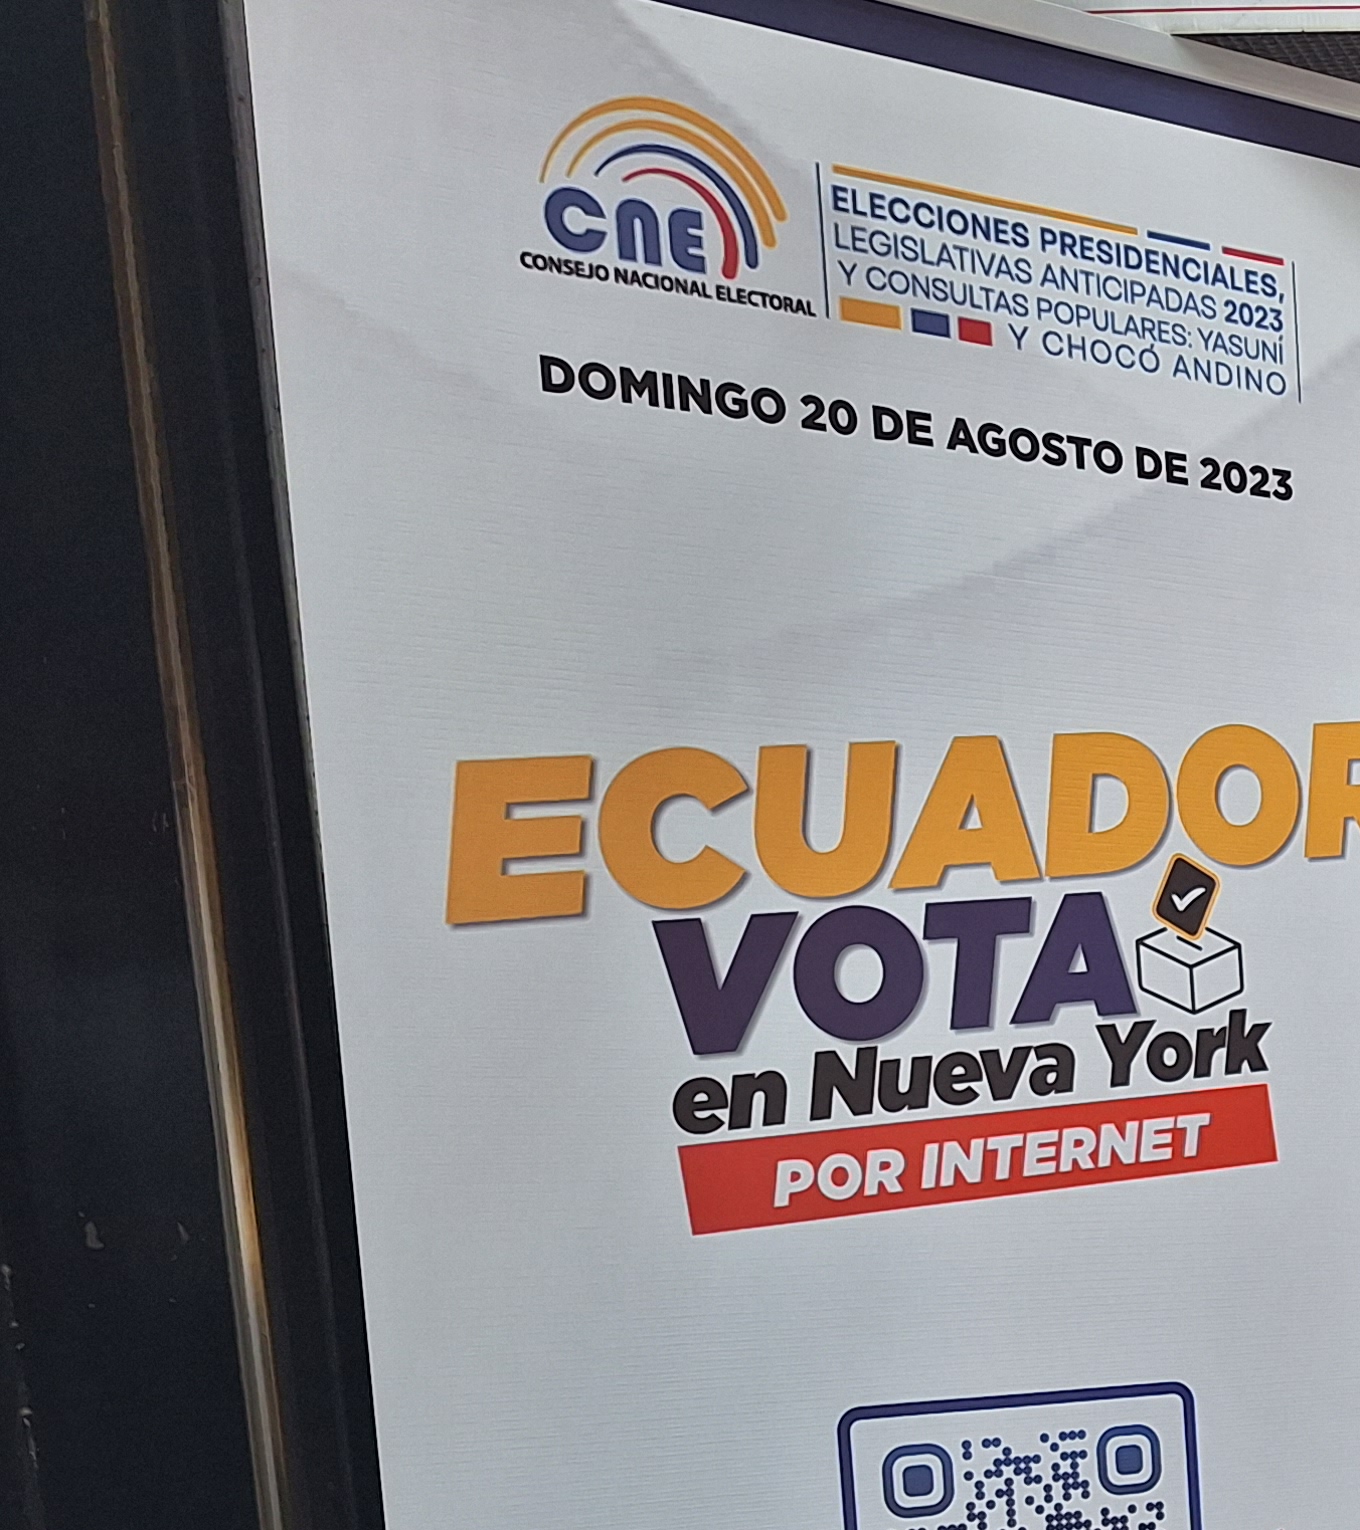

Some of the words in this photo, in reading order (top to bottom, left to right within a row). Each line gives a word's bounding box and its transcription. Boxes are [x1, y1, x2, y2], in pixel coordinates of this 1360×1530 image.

[520, 251, 610, 282] CONSEJO
[613, 265, 713, 299] NACIONAL
[715, 282, 817, 317] ELECTORAL
[830, 184, 1031, 249] ELECCIONES
[1039, 226, 1286, 303] PRESIDENCIALES,
[833, 224, 1034, 286] LEGISLATIVAS
[1039, 262, 1217, 321] ANTICIPADAS
[1223, 300, 1285, 333] 2023
[839, 260, 859, 286] Y
[865, 264, 1030, 317] CONSULTAS
[1037, 296, 1193, 349] POPULARES:
[1197, 326, 1285, 365] YASUNÍ
[1008, 324, 1029, 352] Y
[1042, 327, 1161, 375] CHOCÓ
[1173, 354, 1287, 397] ANDINO
[539, 354, 787, 424] DOMINGO
[800, 393, 858, 435] 20
[872, 405, 934, 447] DE
[946, 417, 1124, 476] AGOSTO
[1136, 448, 1189, 486] DE
[1200, 458, 1293, 501] 2023
[651, 891, 1141, 1056] VOTA
[672, 1067, 787, 1135] en
[810, 1043, 1075, 1122] Nueva
[1094, 1009, 1272, 1089] York
[772, 1148, 904, 1208] POR
[920, 1111, 1211, 1188] INTERNET
